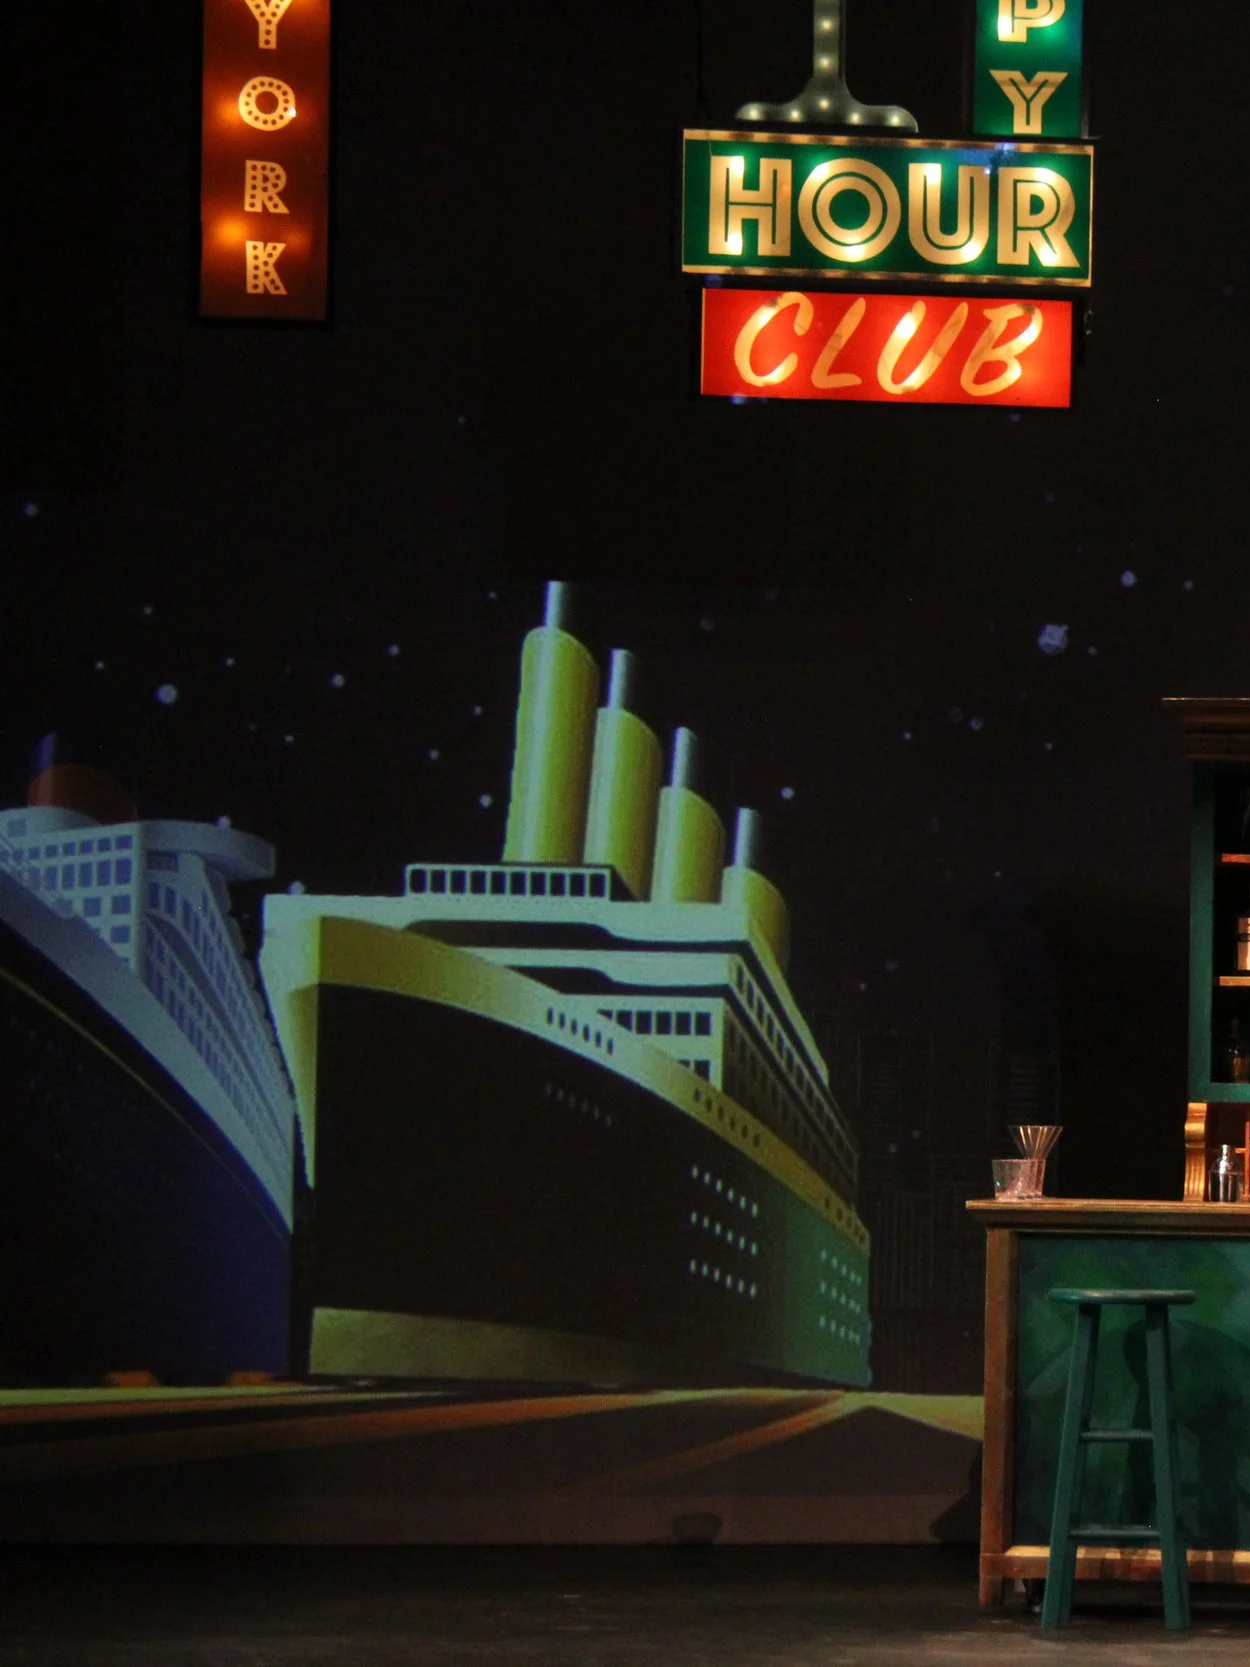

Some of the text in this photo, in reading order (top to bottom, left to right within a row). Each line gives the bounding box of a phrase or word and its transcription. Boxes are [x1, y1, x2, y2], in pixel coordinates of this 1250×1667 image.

[238, 0, 296, 296] YORK
[708, 155, 1080, 268] HOUR
[733, 291, 1043, 397] CLUB
